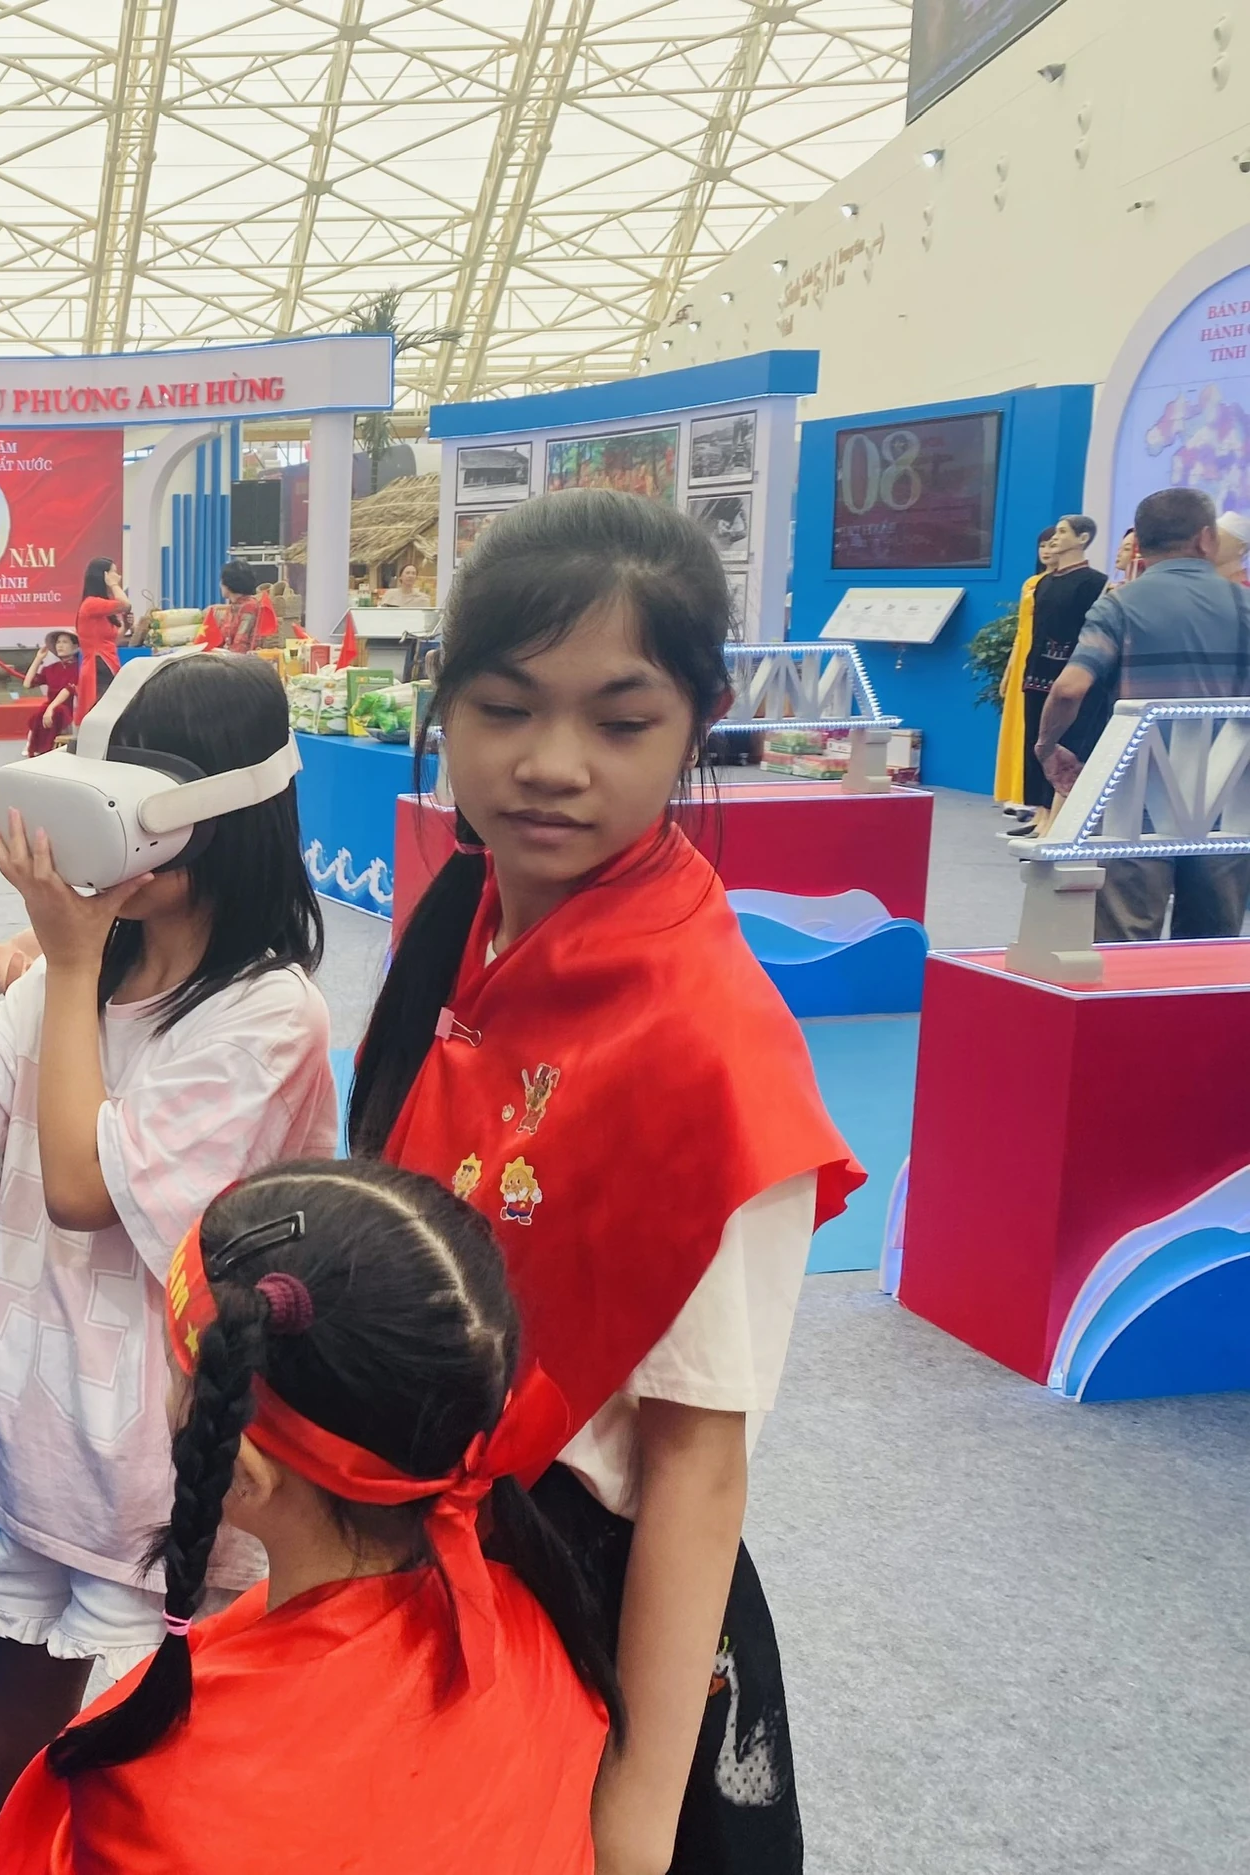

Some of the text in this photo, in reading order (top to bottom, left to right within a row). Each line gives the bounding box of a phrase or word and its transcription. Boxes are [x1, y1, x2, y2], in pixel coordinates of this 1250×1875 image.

[13, 385, 130, 413] PHƯƠNG
[136, 383, 199, 410] ANH
[205, 372, 284, 405] HÙNG
[17, 457, 53, 471] NƯỚC
[9, 544, 56, 568] NĂM
[0, 594, 30, 605] HẠNH
[33, 590, 61, 603] PHÚC
